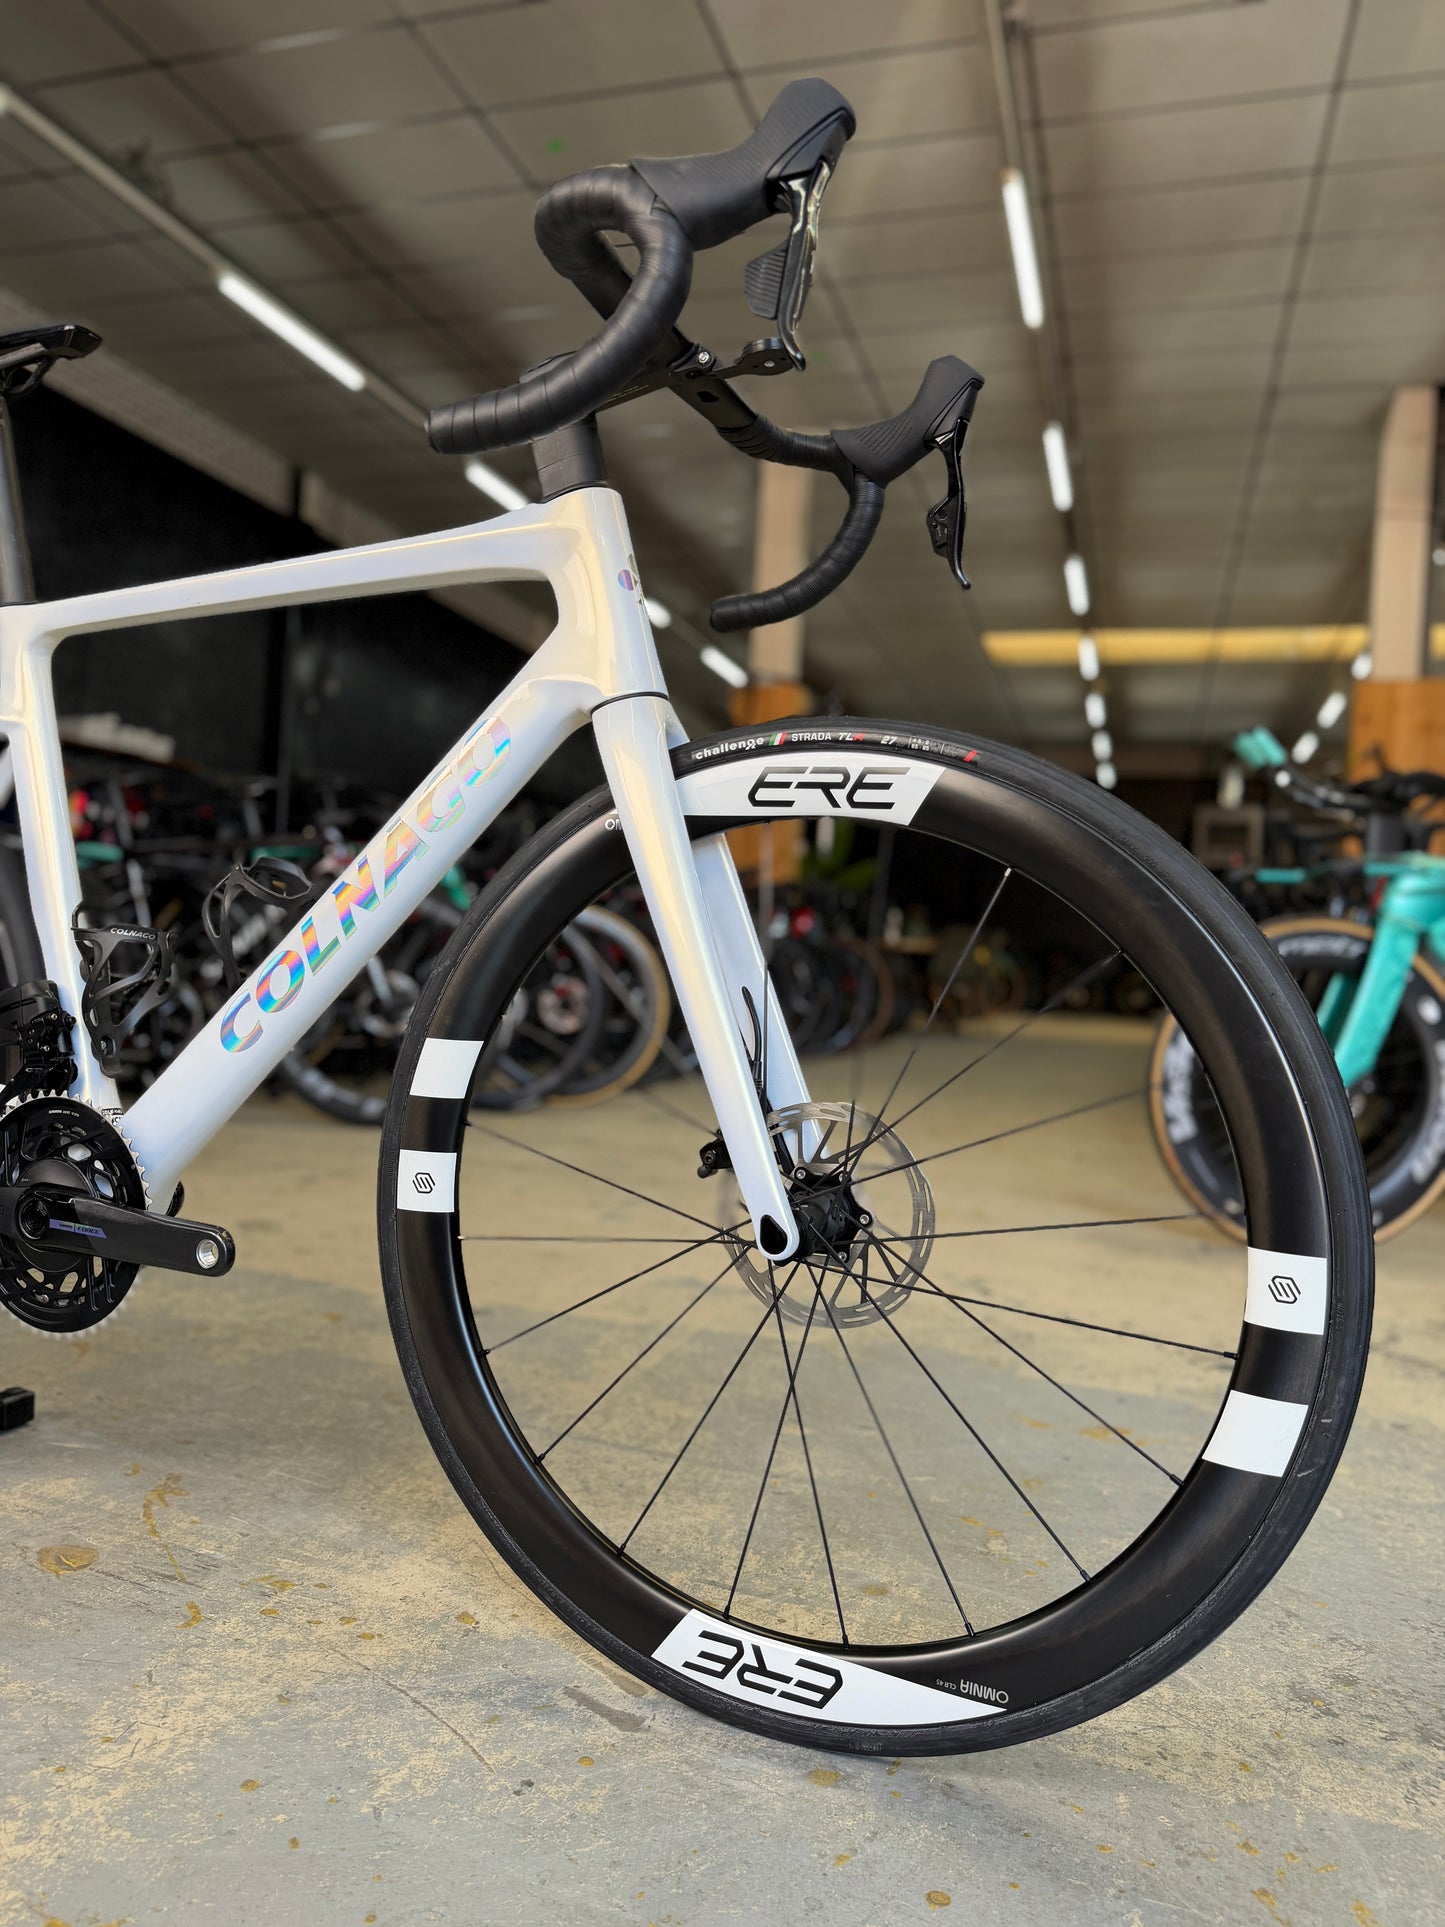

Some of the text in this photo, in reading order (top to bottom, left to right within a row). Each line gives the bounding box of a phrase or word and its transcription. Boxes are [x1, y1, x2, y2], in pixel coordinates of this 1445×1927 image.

[695, 736, 765, 760] challenge
[791, 732, 831, 742] STRADA
[880, 735, 898, 745] 27
[747, 766, 910, 810] ERE
[220, 716, 511, 1052] COLNAGO
[110, 927, 156, 940] COLNAGO
[681, 1630, 843, 1710] ERE
[944, 1681, 957, 1690] CLR
[960, 1678, 1009, 1704] OMNIA
